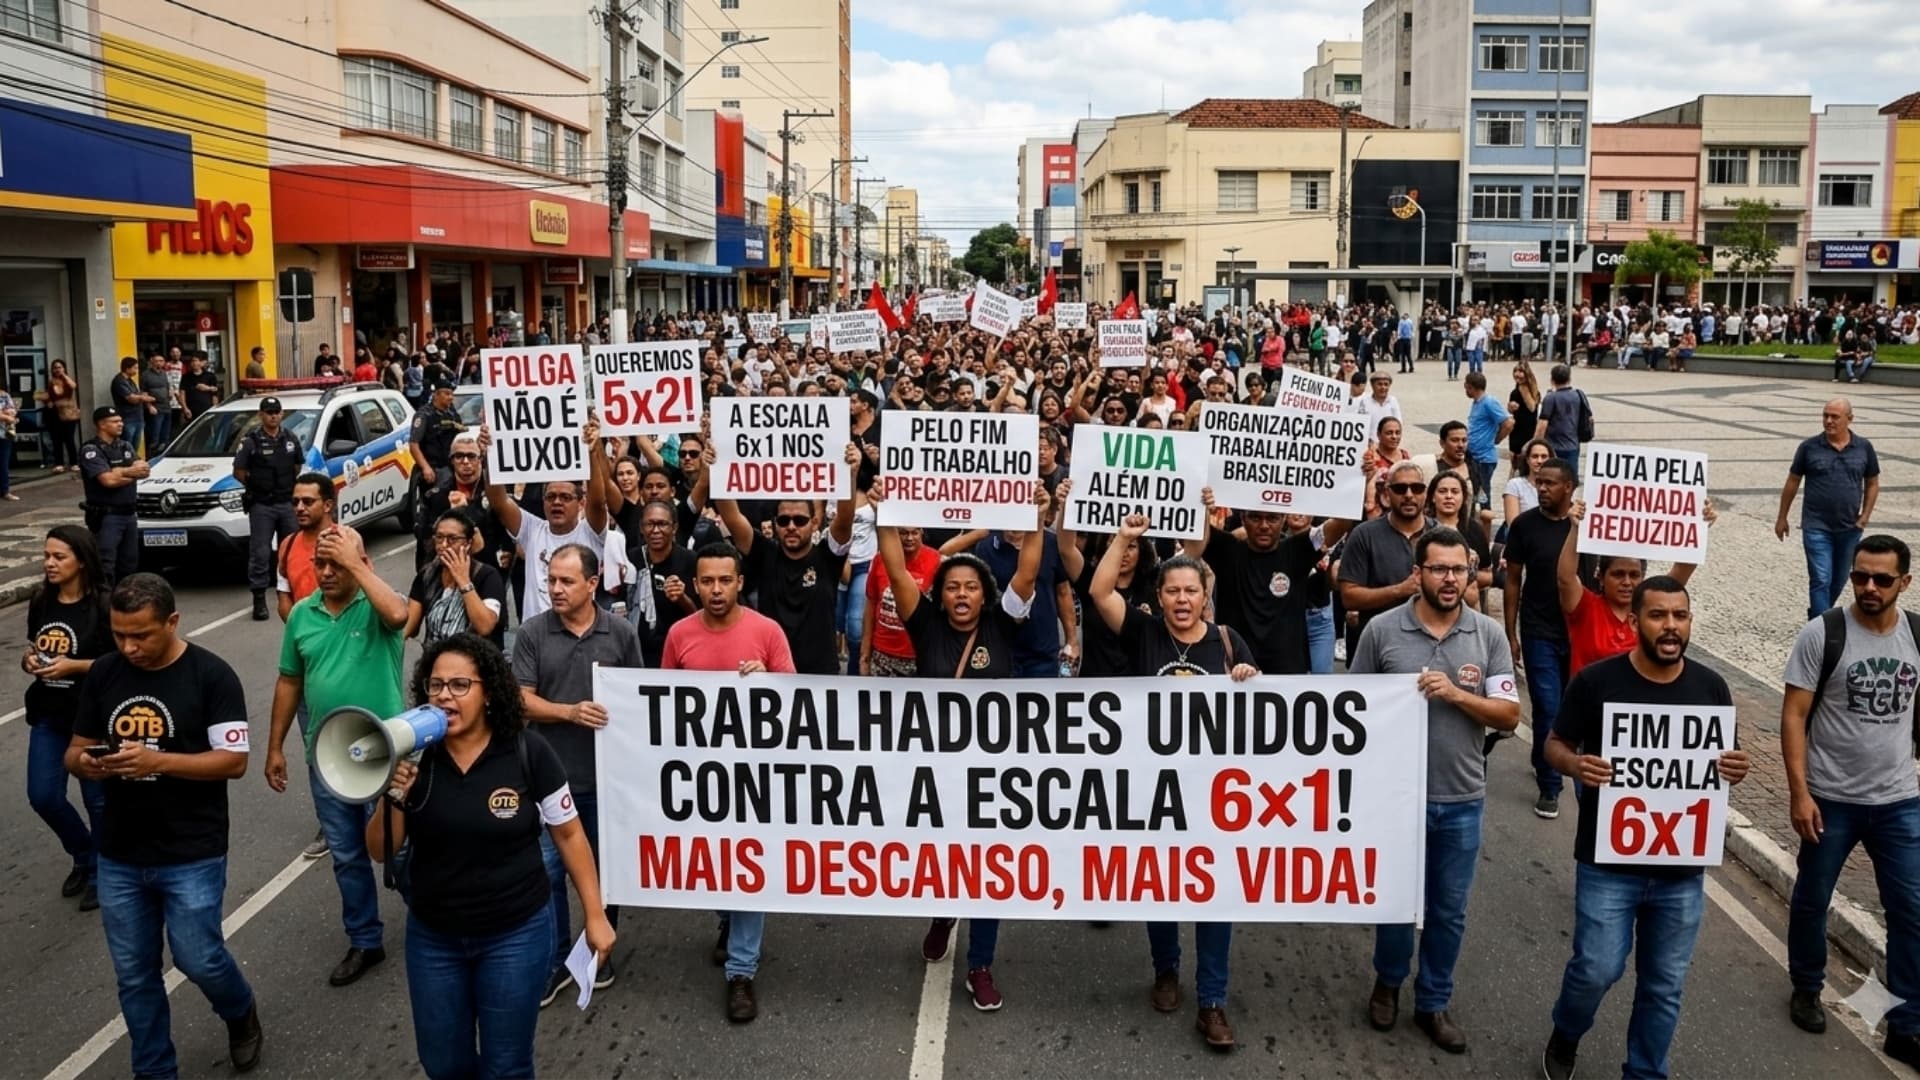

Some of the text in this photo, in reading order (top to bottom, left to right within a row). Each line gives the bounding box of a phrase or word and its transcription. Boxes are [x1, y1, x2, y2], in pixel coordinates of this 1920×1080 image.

[488, 354, 576, 387] FOLGA
[595, 349, 694, 375] QUEREMOS
[494, 388, 578, 431] NÃO É
[603, 377, 695, 426] 5x2!
[730, 404, 830, 428] A ESCALA
[911, 418, 1007, 445] PELO FIM
[1205, 410, 1365, 442] ORGANIZAÇÃO DOS
[498, 436, 582, 473] LUXO!
[736, 434, 824, 458] 6x1 NOS
[886, 447, 1031, 475] DO TRABALHO
[1103, 432, 1177, 471] VIDA
[1210, 435, 1357, 467] TRABALHADORES
[726, 463, 836, 493] ADOECE!
[1223, 461, 1336, 489] BRASILEIROS
[1592, 452, 1705, 486] LUTA PELA
[884, 476, 1033, 504] PRECARIZADO!
[1088, 470, 1185, 502] ALÉM DO
[1262, 489, 1292, 503] OTB
[1595, 484, 1697, 516] JORNADA
[942, 508, 971, 519] OTB
[1589, 513, 1698, 548] REDUZIDA
[37, 634, 70, 653] OTB
[115, 715, 164, 737] OTB
[639, 685, 1367, 756] TRABALHADORES UNIDOS
[1611, 713, 1724, 749] FIM DA
[1610, 757, 1721, 790] ESCALA
[660, 760, 884, 828] CONTRA
[906, 767, 944, 828] A
[967, 767, 1188, 831] ESCALA
[1610, 797, 1710, 857] 6x1
[639, 835, 1377, 910] MAIS DESCANSO, MAIS VIDA!
